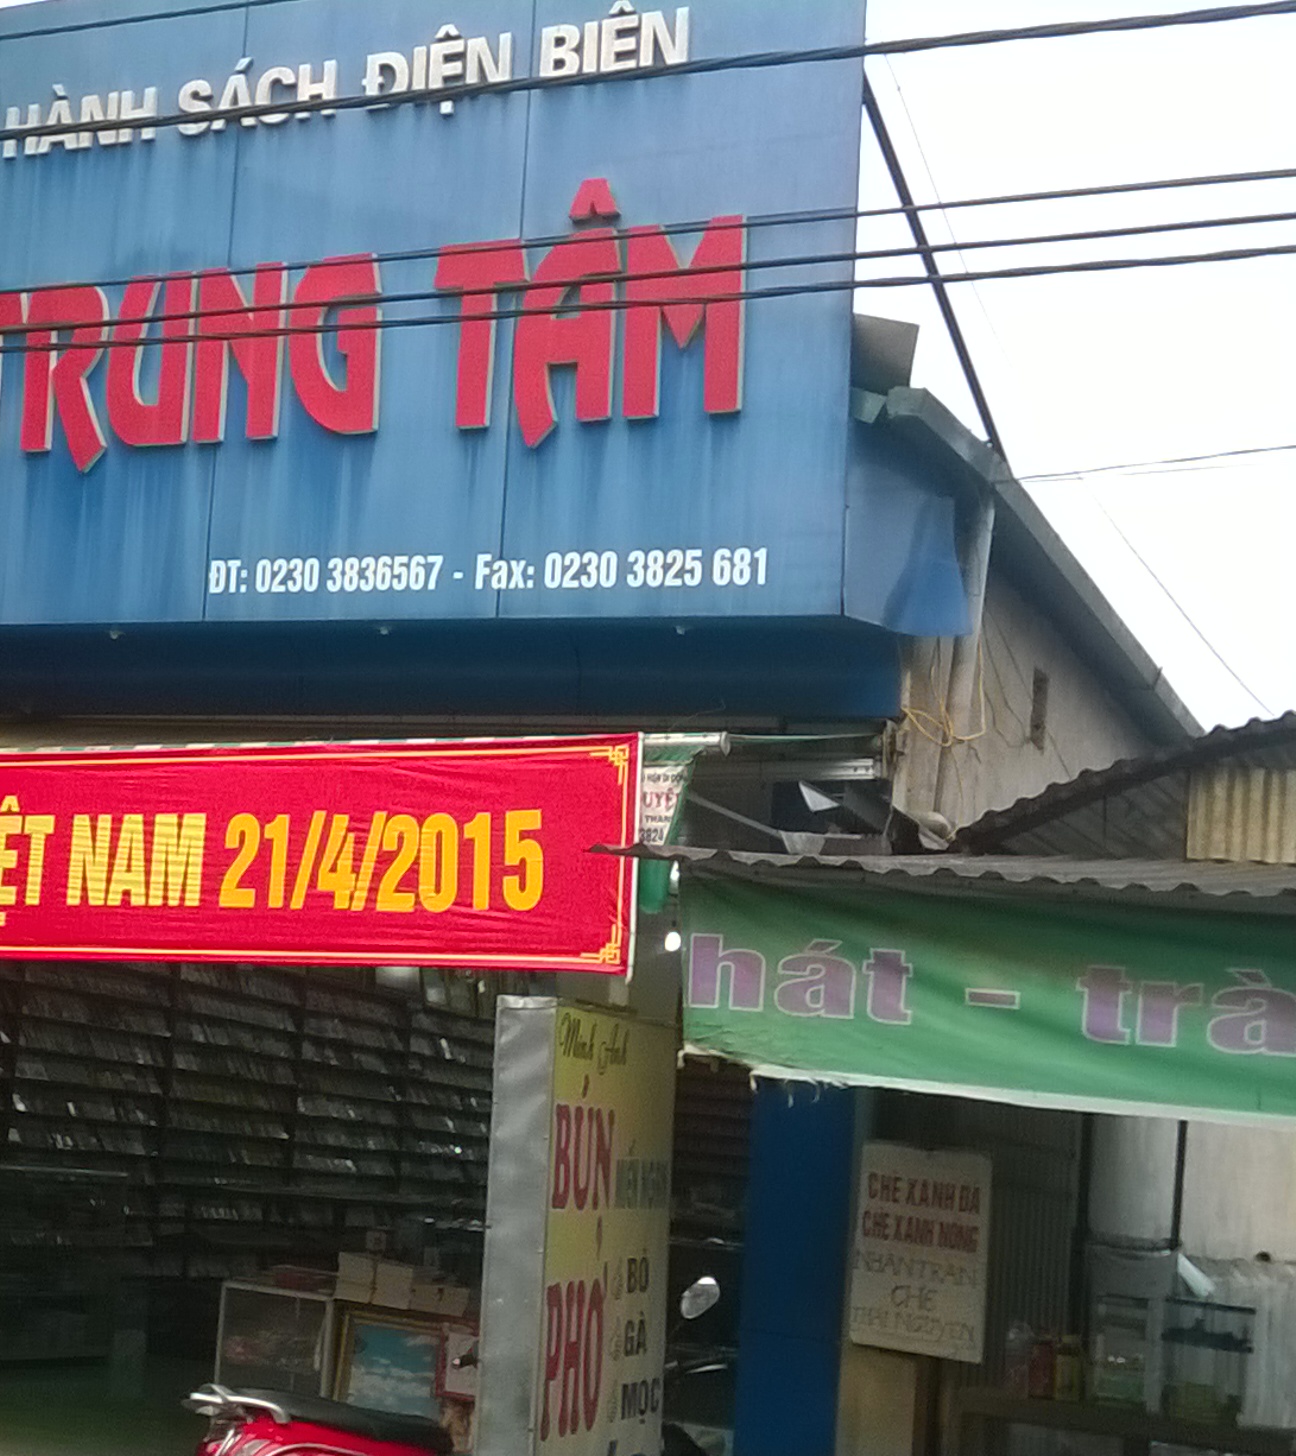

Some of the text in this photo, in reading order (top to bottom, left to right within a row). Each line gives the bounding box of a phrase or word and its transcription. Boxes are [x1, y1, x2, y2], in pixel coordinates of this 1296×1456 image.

[2, 84, 157, 158] HÀNH
[178, 57, 338, 136] SÁCH
[362, 25, 513, 116] ĐIỆN
[539, 1, 690, 78] BIÊN
[434, 177, 747, 449] TÂM
[208, 559, 248, 594] ĐT:
[255, 558, 319, 593] 0230
[326, 555, 444, 593] 3836567
[474, 553, 535, 590] Fax:
[543, 551, 617, 589] 0230
[626, 548, 703, 587] 3825
[712, 546, 768, 586] 681
[65, 811, 207, 907] NAM
[217, 808, 545, 914] 21/4/2015
[1075, 966, 1296, 1057] trà
[551, 1073, 615, 1211] BÚN
